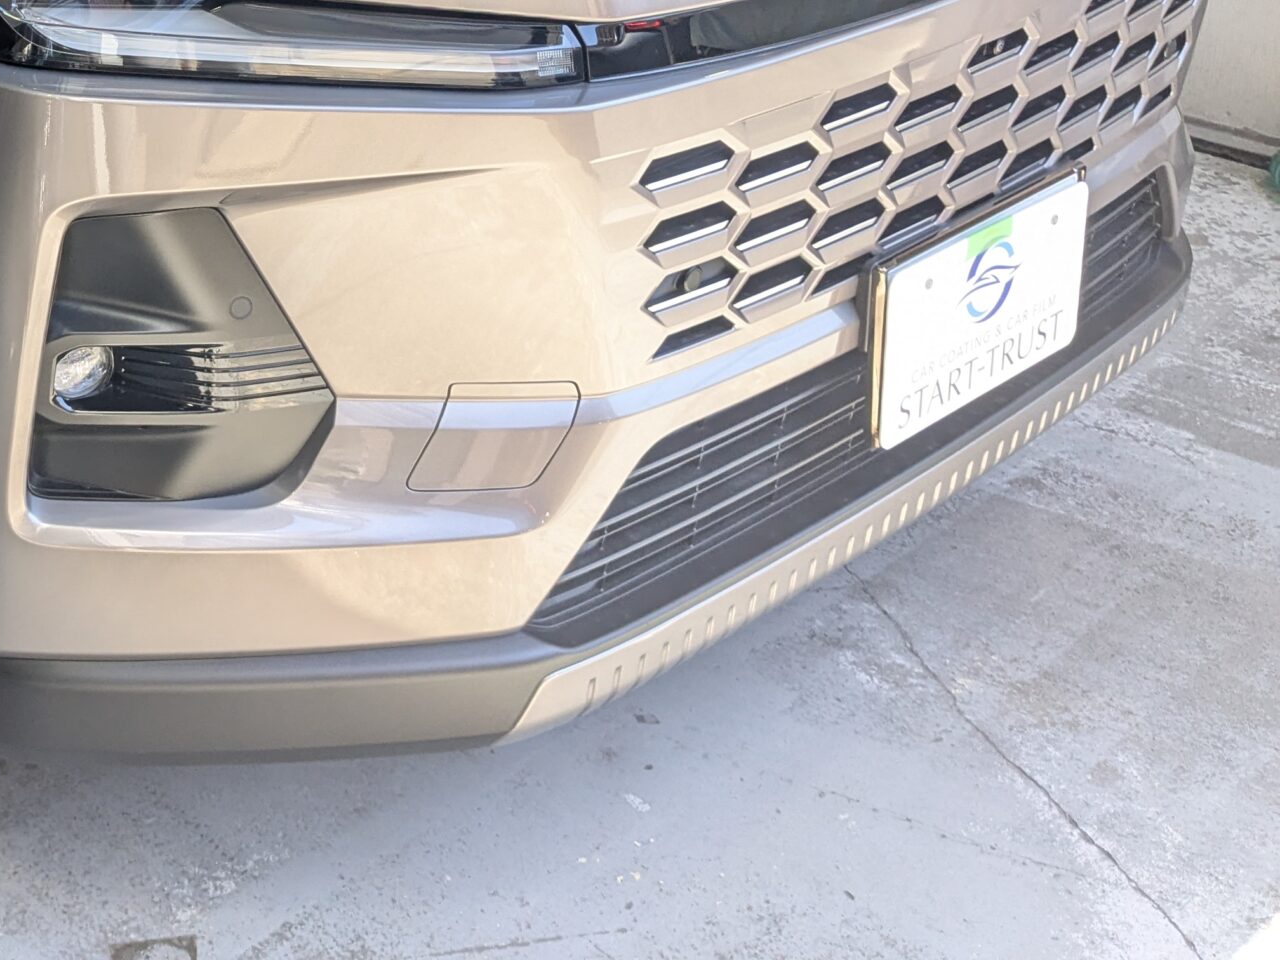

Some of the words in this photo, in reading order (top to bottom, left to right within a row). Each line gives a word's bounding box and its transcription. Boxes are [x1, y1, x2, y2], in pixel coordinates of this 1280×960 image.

[898, 309, 1063, 429] START-TRUST
[911, 360, 935, 384] CAR
[939, 331, 991, 369] COATING
[995, 324, 1003, 337] &
[1006, 309, 1028, 331] CAR
[1032, 294, 1057, 317] FILM
